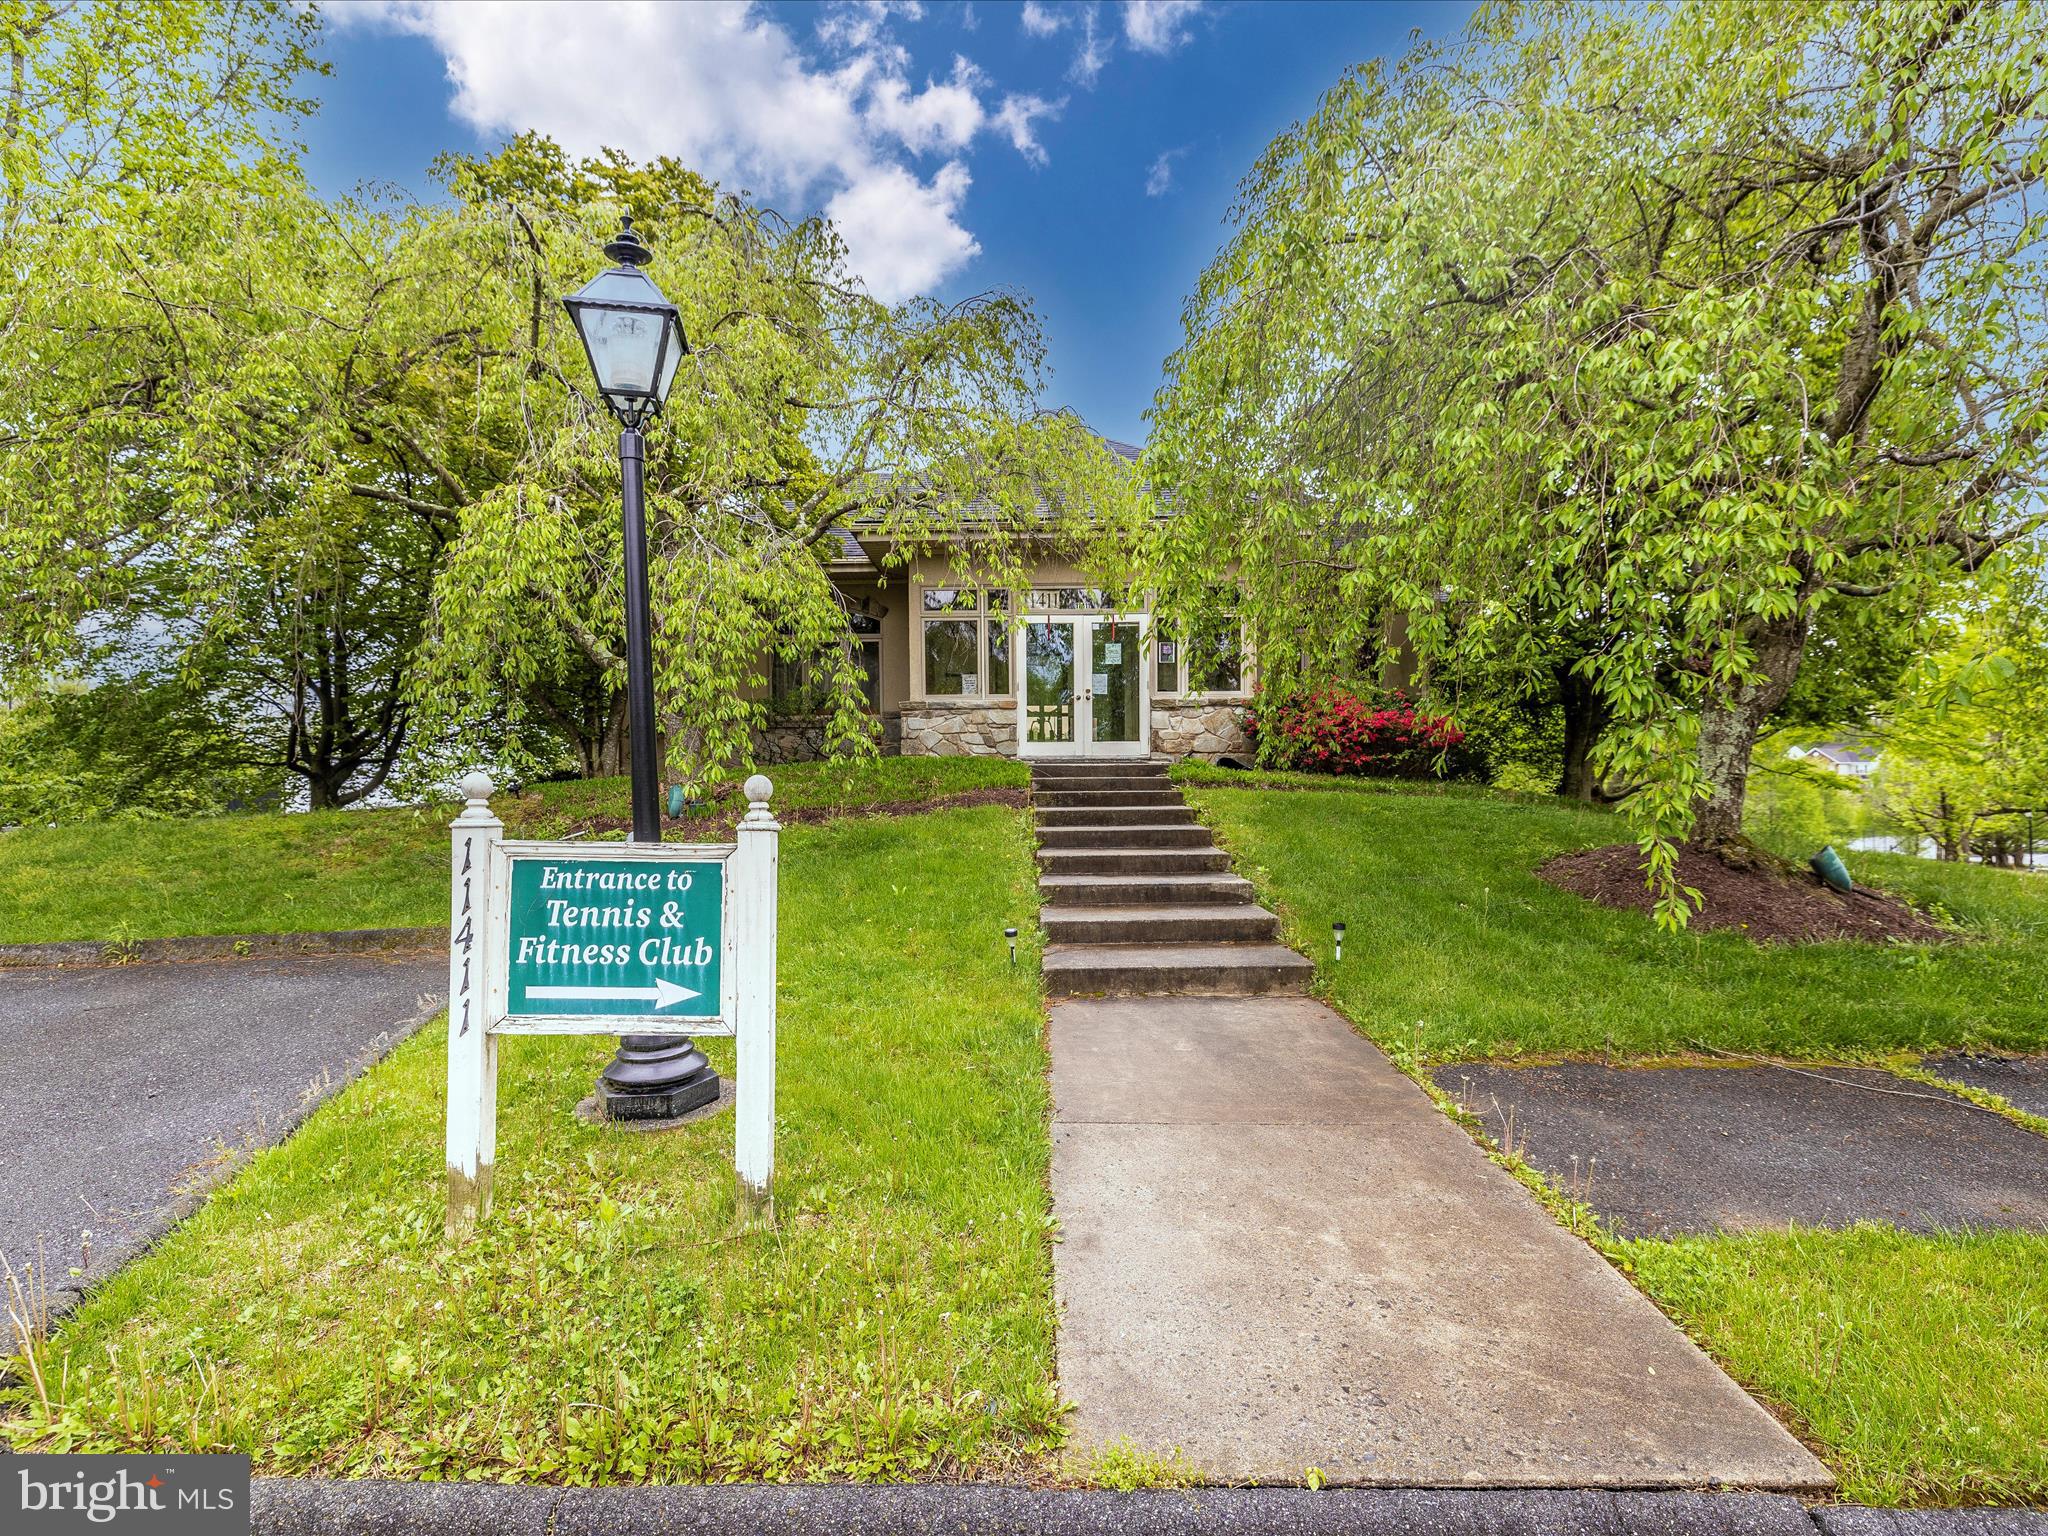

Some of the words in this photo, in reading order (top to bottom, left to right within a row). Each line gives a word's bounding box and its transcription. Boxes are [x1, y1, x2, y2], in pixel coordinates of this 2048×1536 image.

[540, 867, 661, 890] Entrance
[667, 869, 693, 890] to
[547, 899, 651, 928] Tennis
[659, 901, 684, 928] &
[454, 837, 474, 1037] 11411
[516, 935, 630, 965] Fitness
[639, 937, 713, 966] Club
